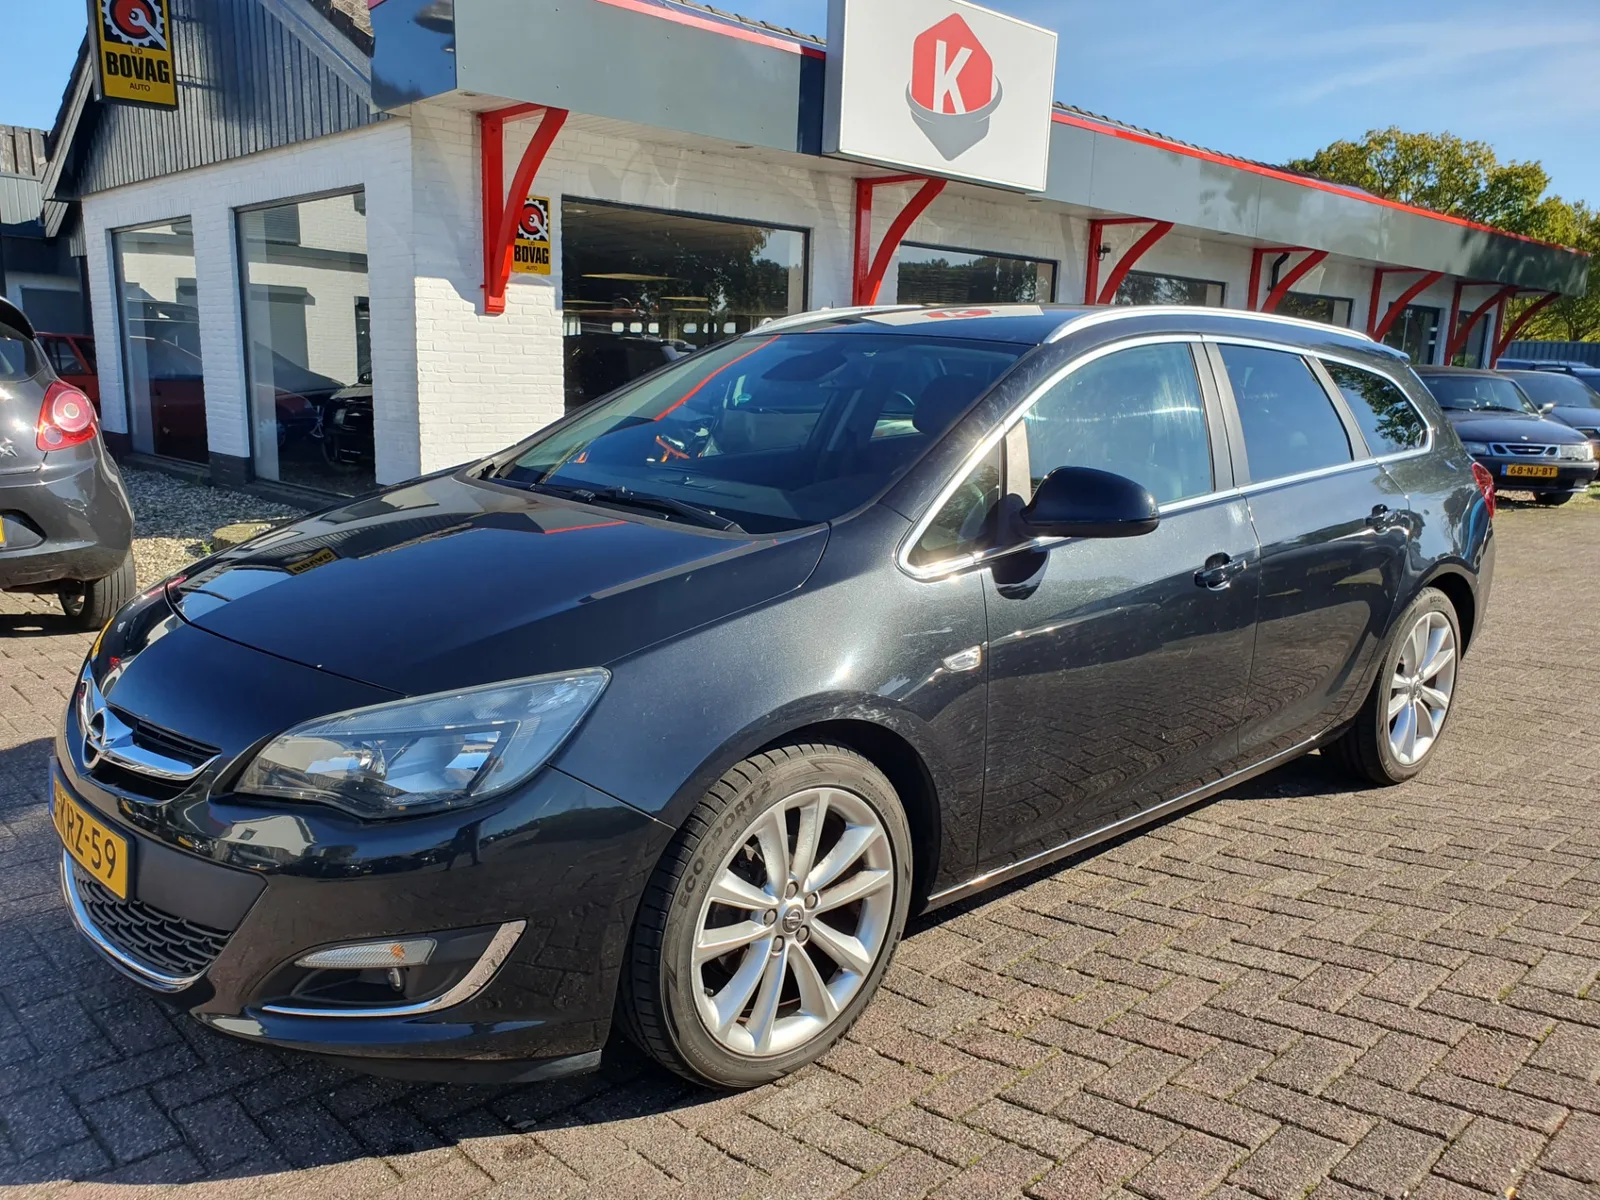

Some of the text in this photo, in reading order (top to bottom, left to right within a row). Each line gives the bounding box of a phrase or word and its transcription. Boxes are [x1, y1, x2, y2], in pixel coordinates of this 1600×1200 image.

[106, 52, 170, 84] BOVAG
[932, 39, 973, 114] K
[130, 83, 150, 92] AUTO
[514, 245, 549, 264] BOVAG
[1510, 466, 1554, 476] 68-NJ-BT
